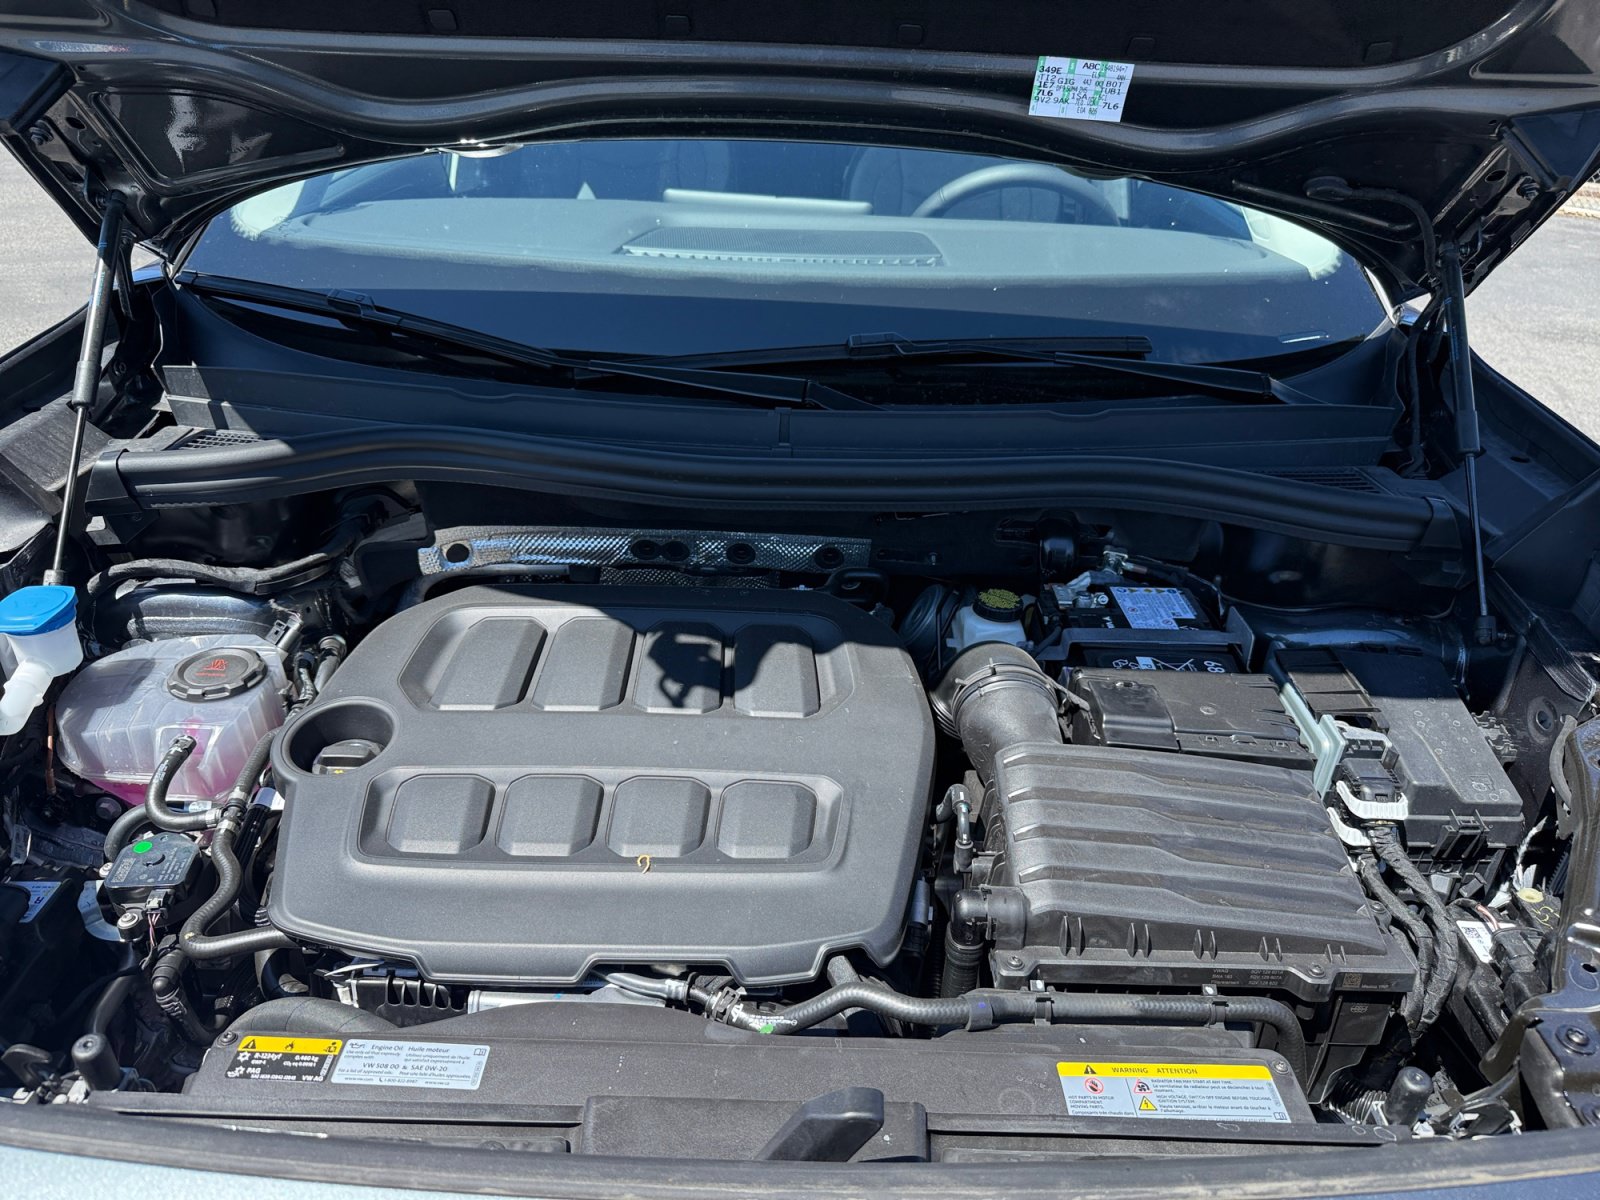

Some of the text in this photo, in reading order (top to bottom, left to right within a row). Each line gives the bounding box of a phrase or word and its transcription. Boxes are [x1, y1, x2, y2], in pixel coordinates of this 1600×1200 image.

[1038, 65, 1063, 74] 349E
[1082, 62, 1100, 71] ABC
[1038, 81, 1055, 89] 1E7
[1037, 89, 1053, 97] 7L6
[1034, 95, 1050, 104] 9V2
[1102, 102, 1119, 110] 7L6
